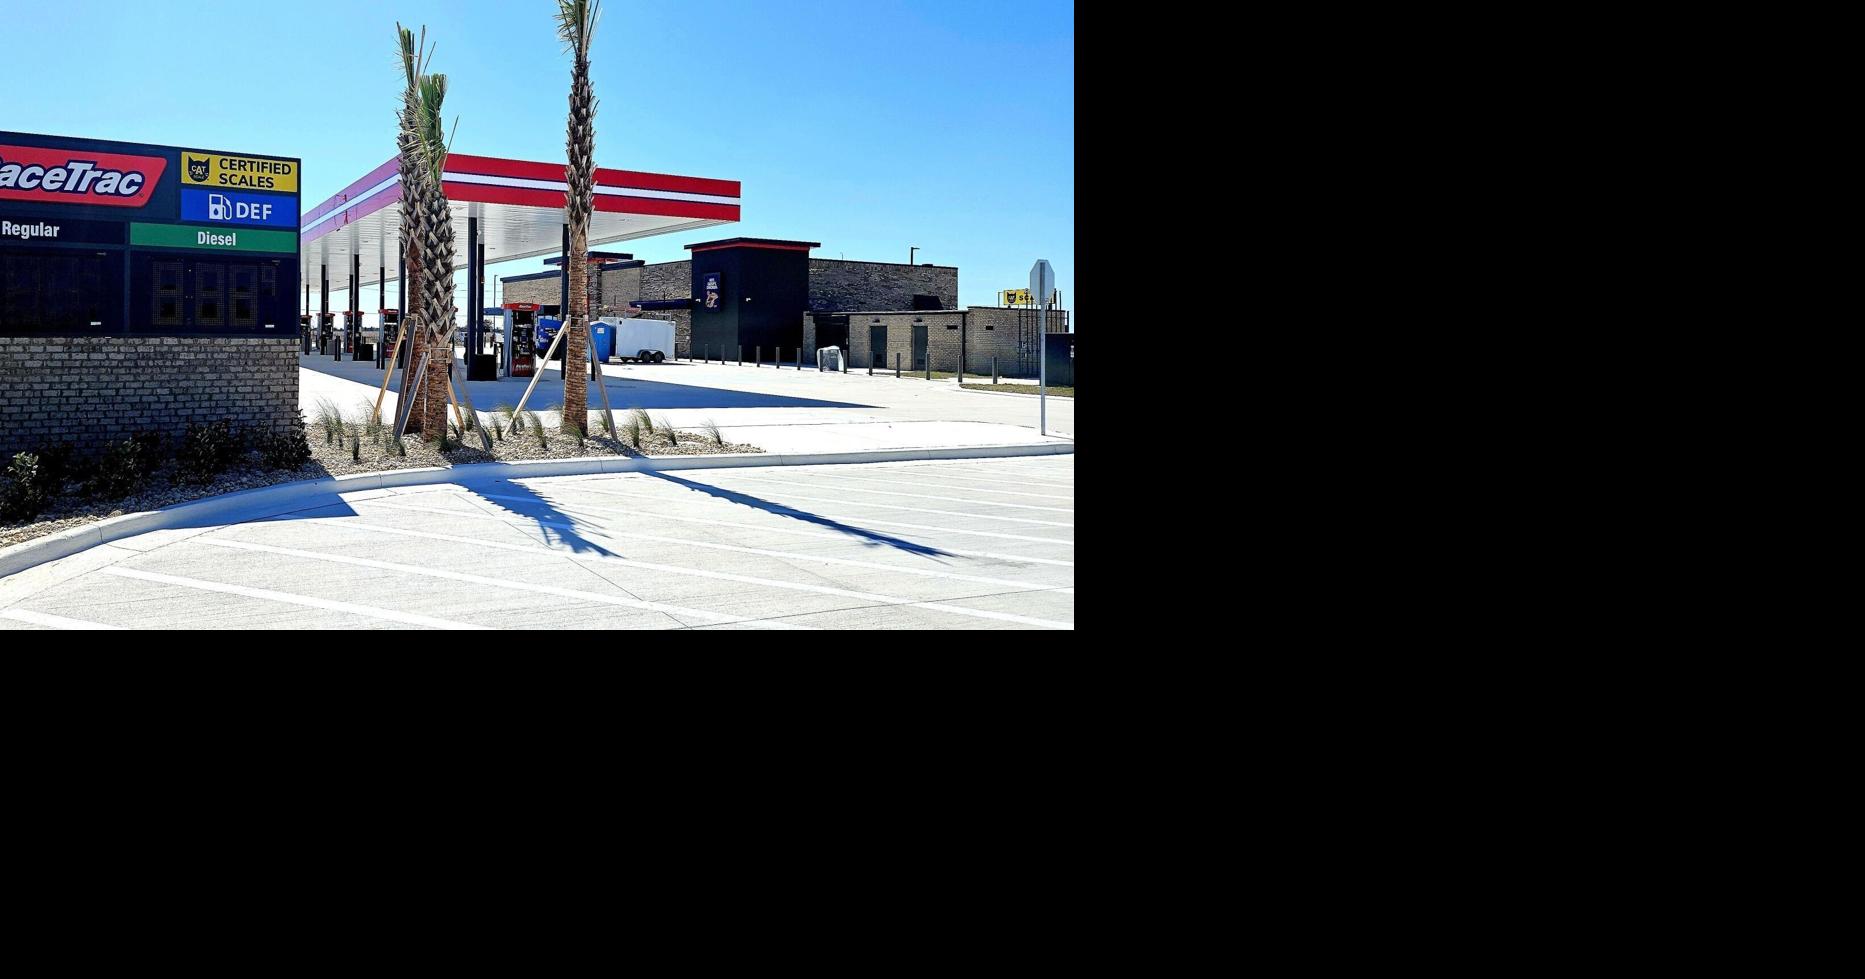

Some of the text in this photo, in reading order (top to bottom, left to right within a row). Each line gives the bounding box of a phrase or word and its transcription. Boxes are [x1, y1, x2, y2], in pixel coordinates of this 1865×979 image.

[191, 165, 206, 175] CAT
[219, 158, 292, 175] CERTIFIED
[0, 161, 144, 196] aceTrac
[219, 173, 274, 188] SCALES
[236, 202, 272, 220] DEF
[1, 221, 60, 239] Regular
[197, 231, 236, 246] Diesel
